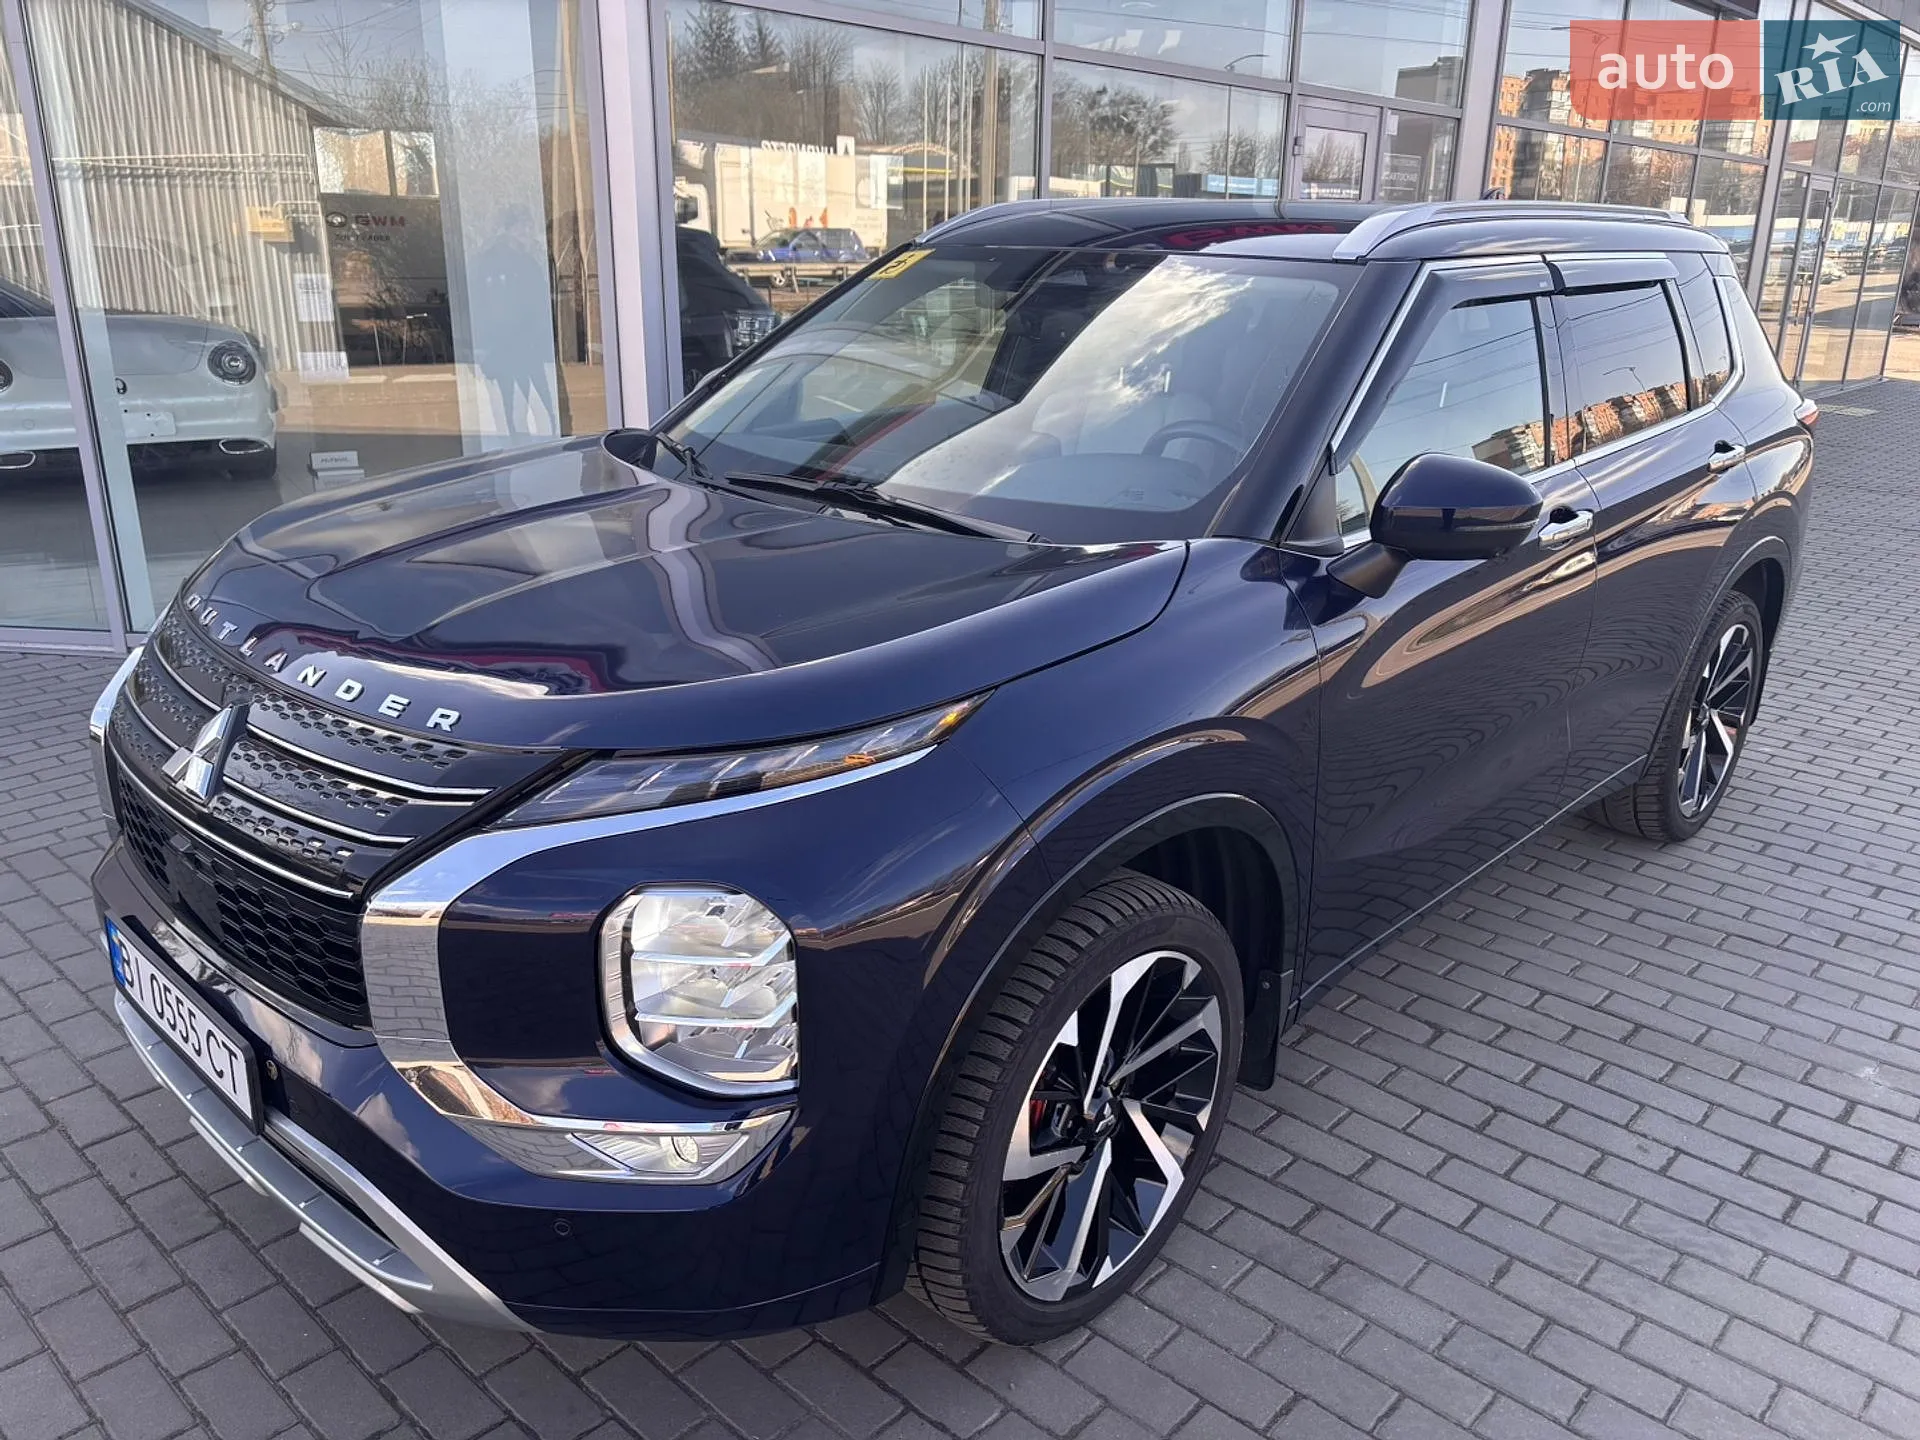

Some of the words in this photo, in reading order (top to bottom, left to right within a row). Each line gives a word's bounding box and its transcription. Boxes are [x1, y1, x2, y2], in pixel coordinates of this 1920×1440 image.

[354, 213, 406, 228] GWM
[185, 593, 463, 732] OUTLANDER
[120, 940, 145, 1002] BI
[150, 972, 202, 1058] 0555
[205, 1029, 239, 1095] CT
